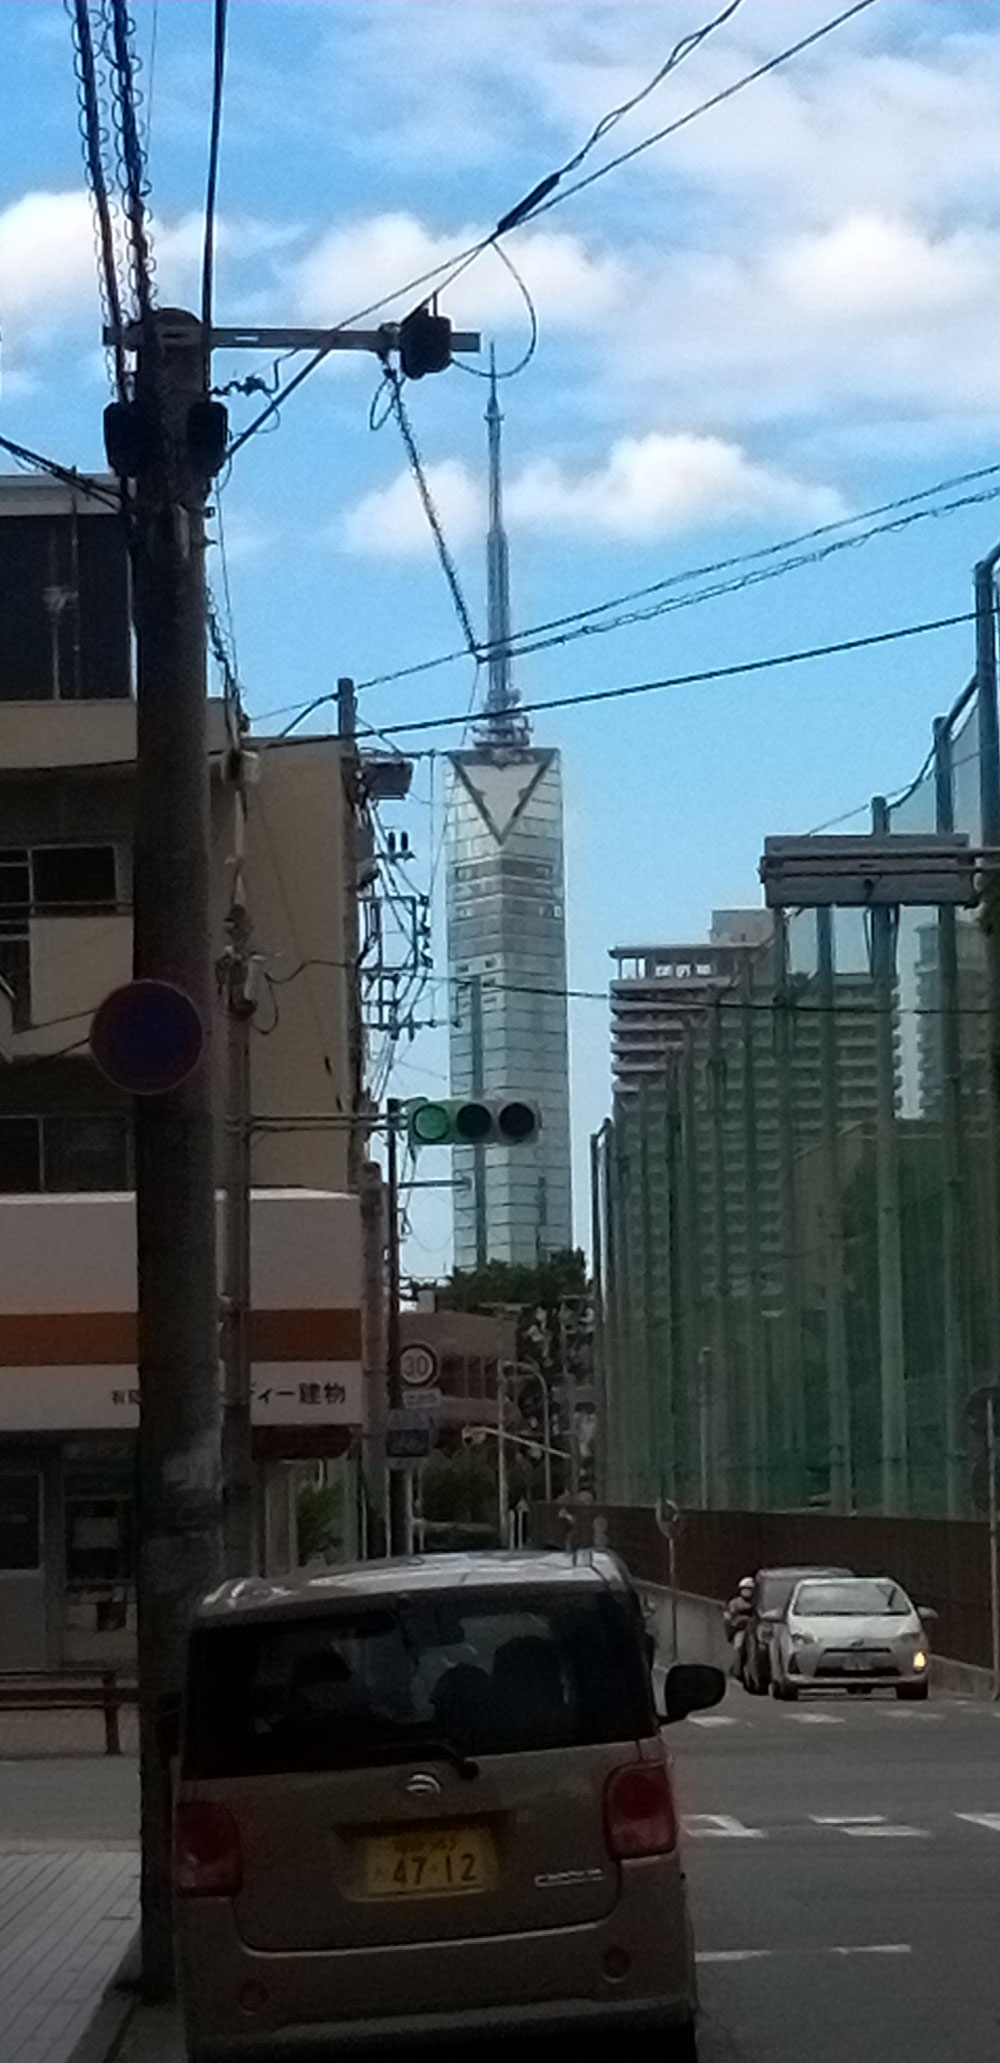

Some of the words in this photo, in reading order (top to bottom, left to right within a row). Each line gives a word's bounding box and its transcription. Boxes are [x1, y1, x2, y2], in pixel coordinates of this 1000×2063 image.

[403, 1354, 430, 1377] 30
[250, 1382, 346, 1405] ィー建物
